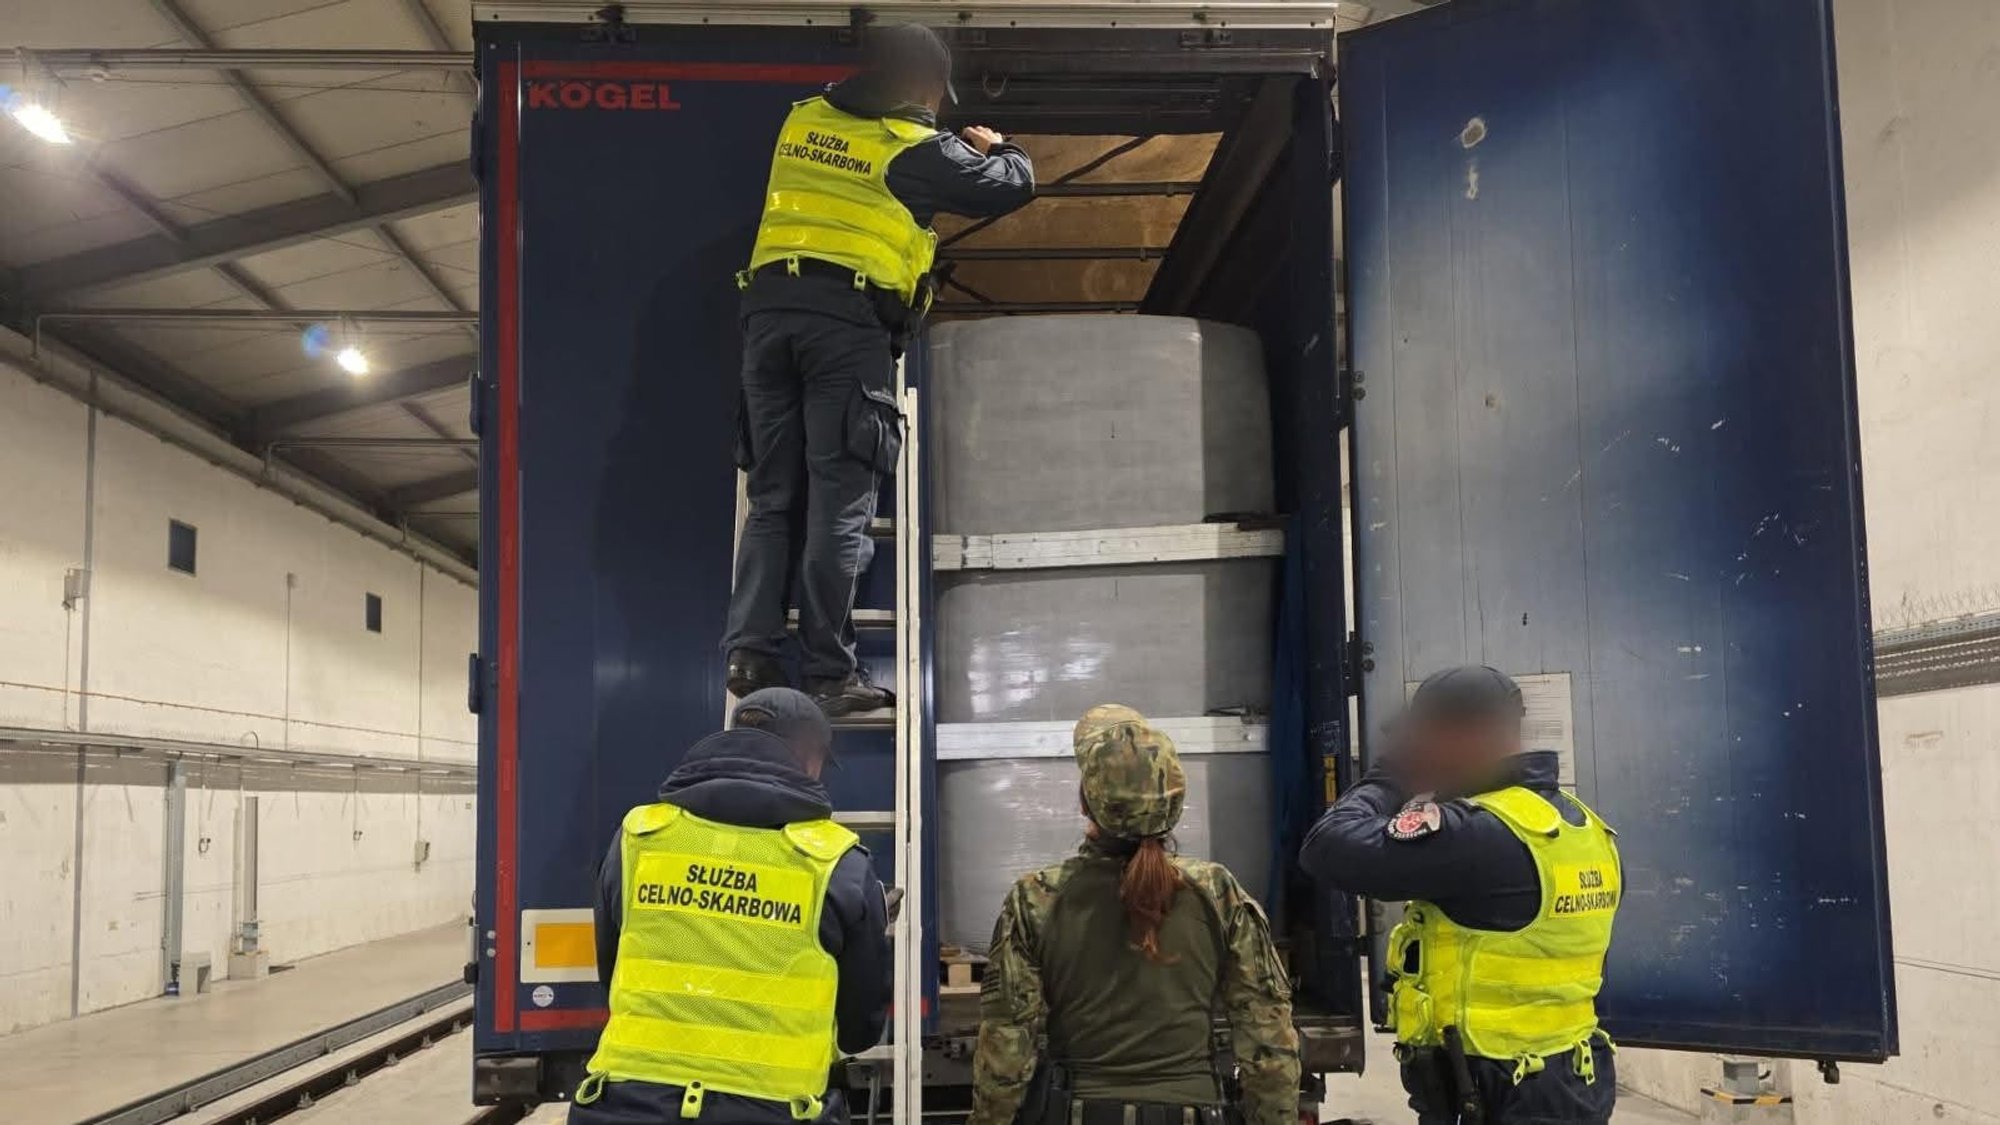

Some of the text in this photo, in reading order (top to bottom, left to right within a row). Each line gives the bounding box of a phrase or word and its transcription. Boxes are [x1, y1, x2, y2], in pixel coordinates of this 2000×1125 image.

[806, 131, 849, 153] SŁUŻBA
[686, 864, 757, 892] SŁUŻBA
[638, 884, 801, 923] CELNO-SKARBOWA
